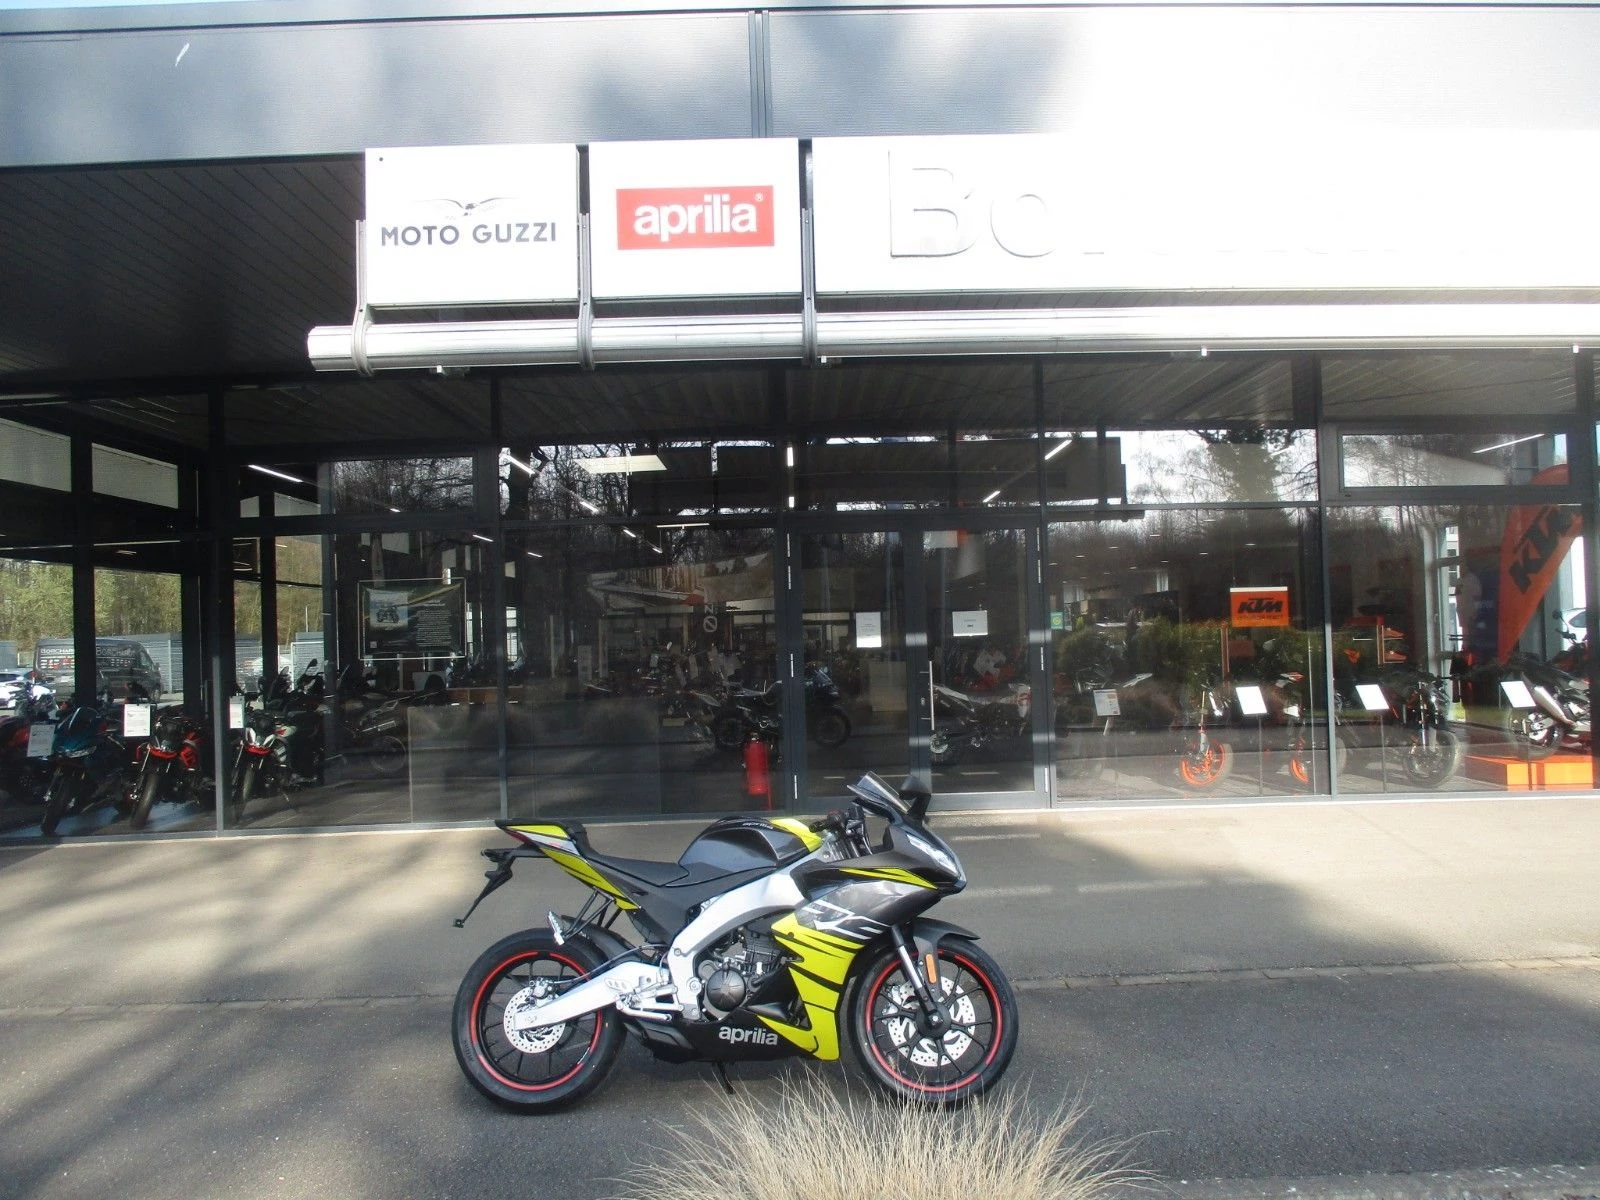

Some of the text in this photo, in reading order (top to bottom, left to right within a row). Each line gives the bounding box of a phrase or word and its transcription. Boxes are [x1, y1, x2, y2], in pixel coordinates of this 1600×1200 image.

[633, 193, 758, 243] aprilia
[381, 221, 556, 246] MOTO GUZZI
[1237, 597, 1284, 614] KTM
[718, 1025, 778, 1046] aprilia
